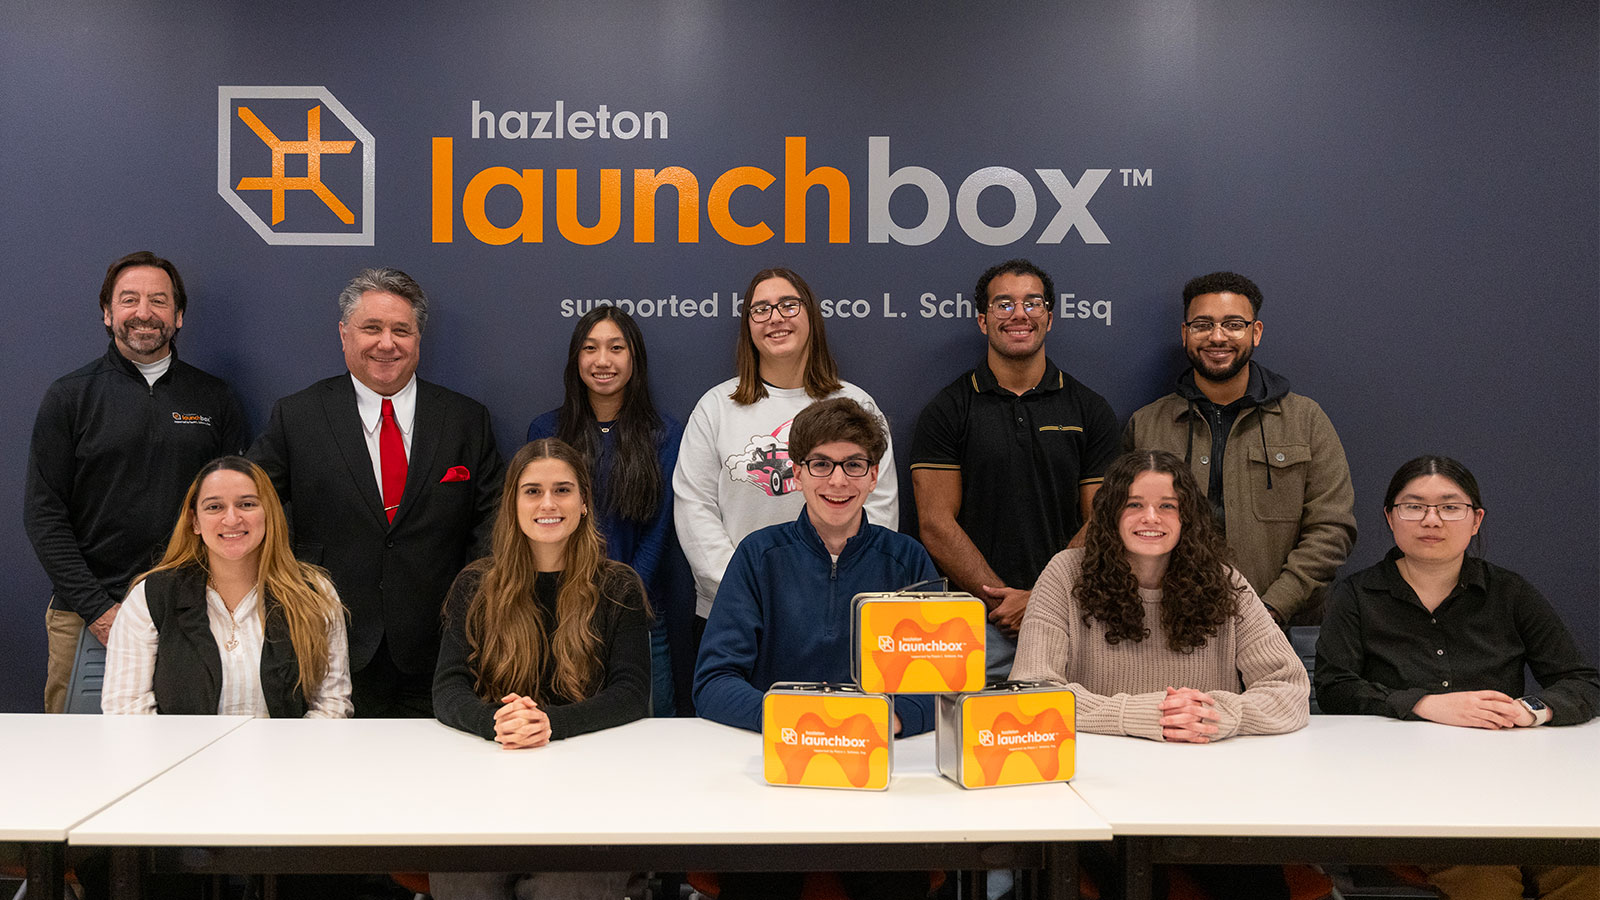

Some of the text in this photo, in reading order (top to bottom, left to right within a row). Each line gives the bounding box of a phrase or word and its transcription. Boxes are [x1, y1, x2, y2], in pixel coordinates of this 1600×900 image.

[471, 100, 669, 140] hazleton
[432, 136, 1112, 246] launchbox
[820, 299, 871, 319] sco
[883, 292, 908, 319] L.
[1060, 293, 1112, 326] Esq
[898, 640, 963, 652] launchbox
[801, 733, 866, 748] launchbox
[997, 731, 1056, 746] launchbox
